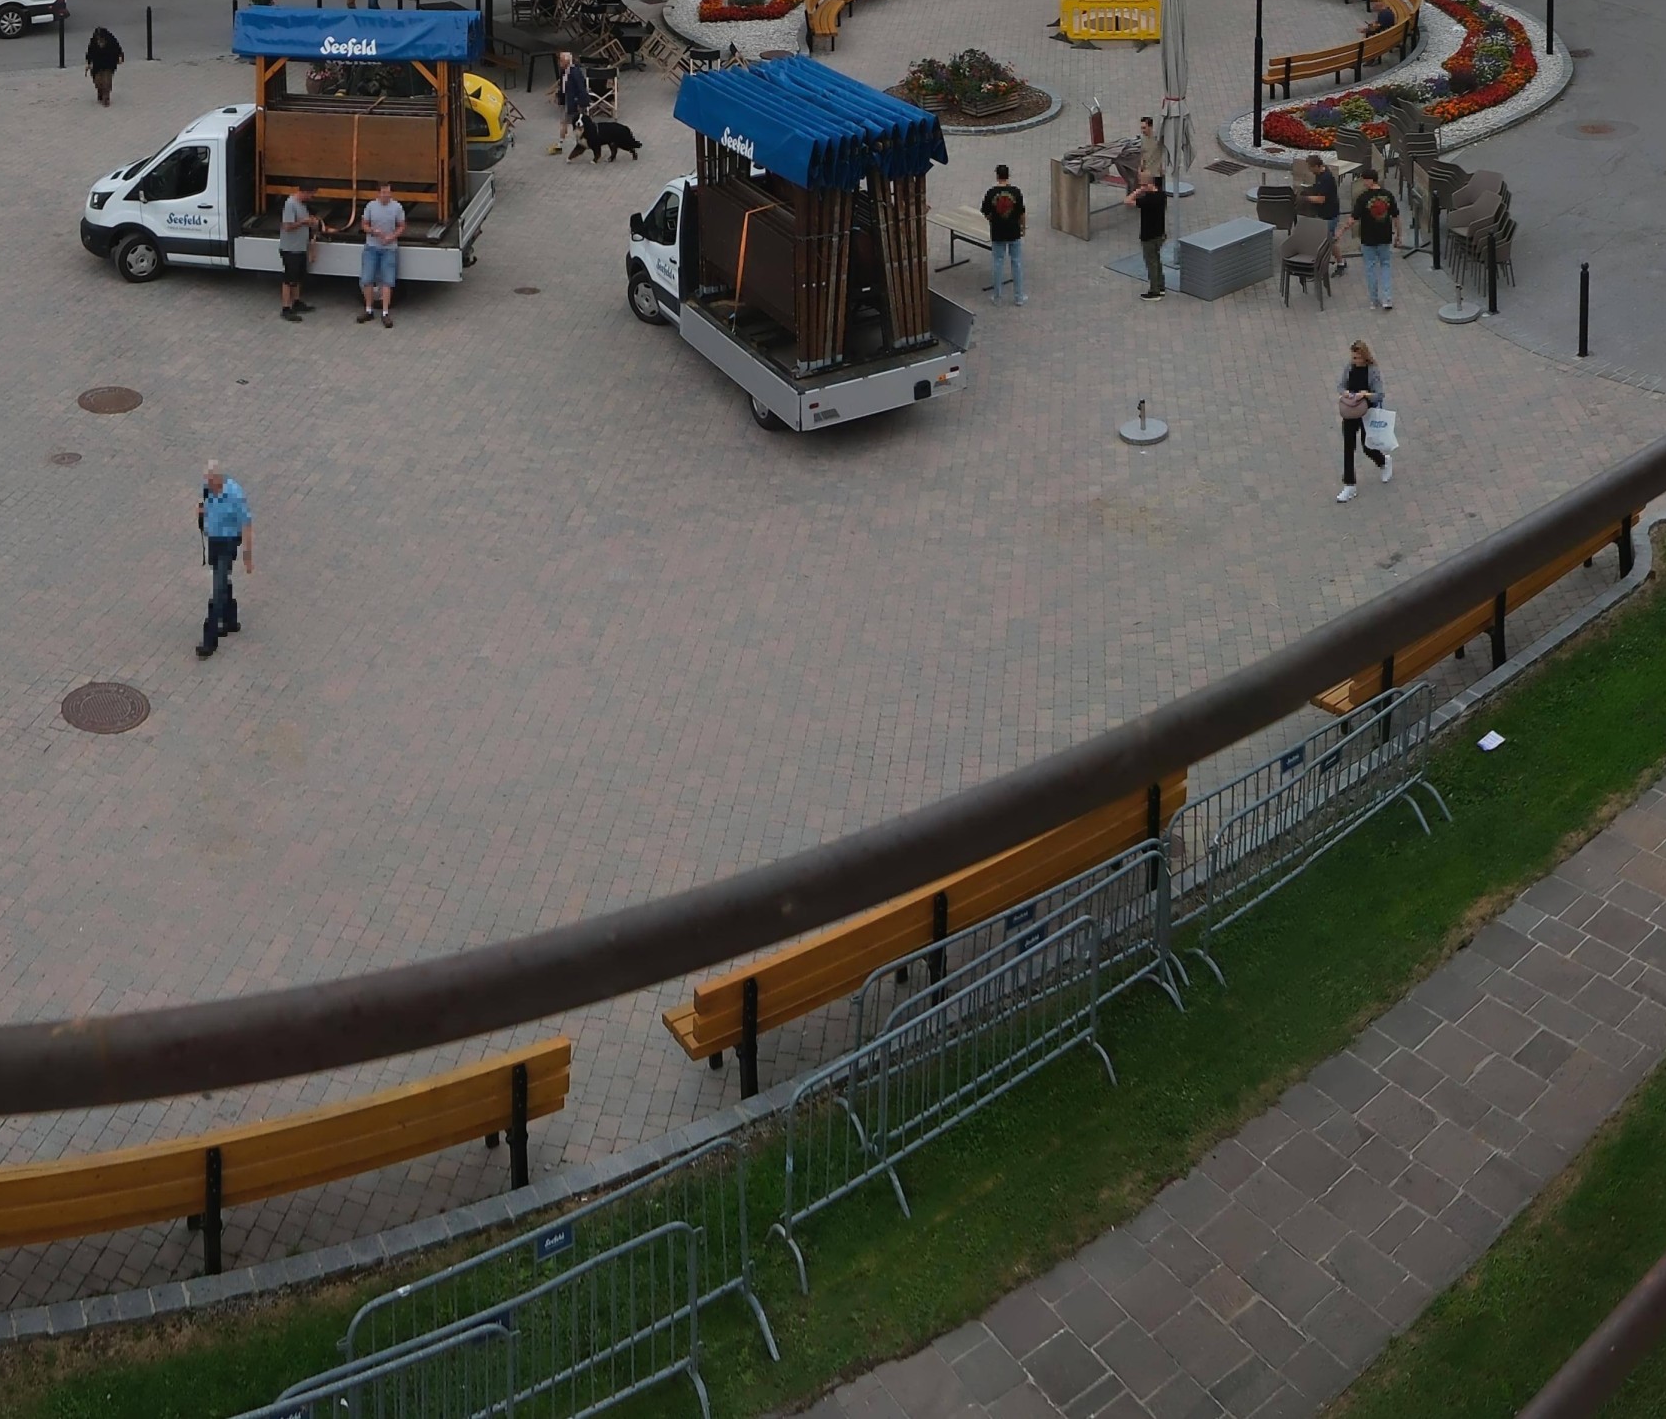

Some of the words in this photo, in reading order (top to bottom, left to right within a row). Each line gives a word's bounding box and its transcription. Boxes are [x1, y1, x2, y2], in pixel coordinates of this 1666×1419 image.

[320, 36, 377, 57] Seefeld
[721, 127, 754, 159] Seefeld
[166, 212, 202, 226] Seefeld
